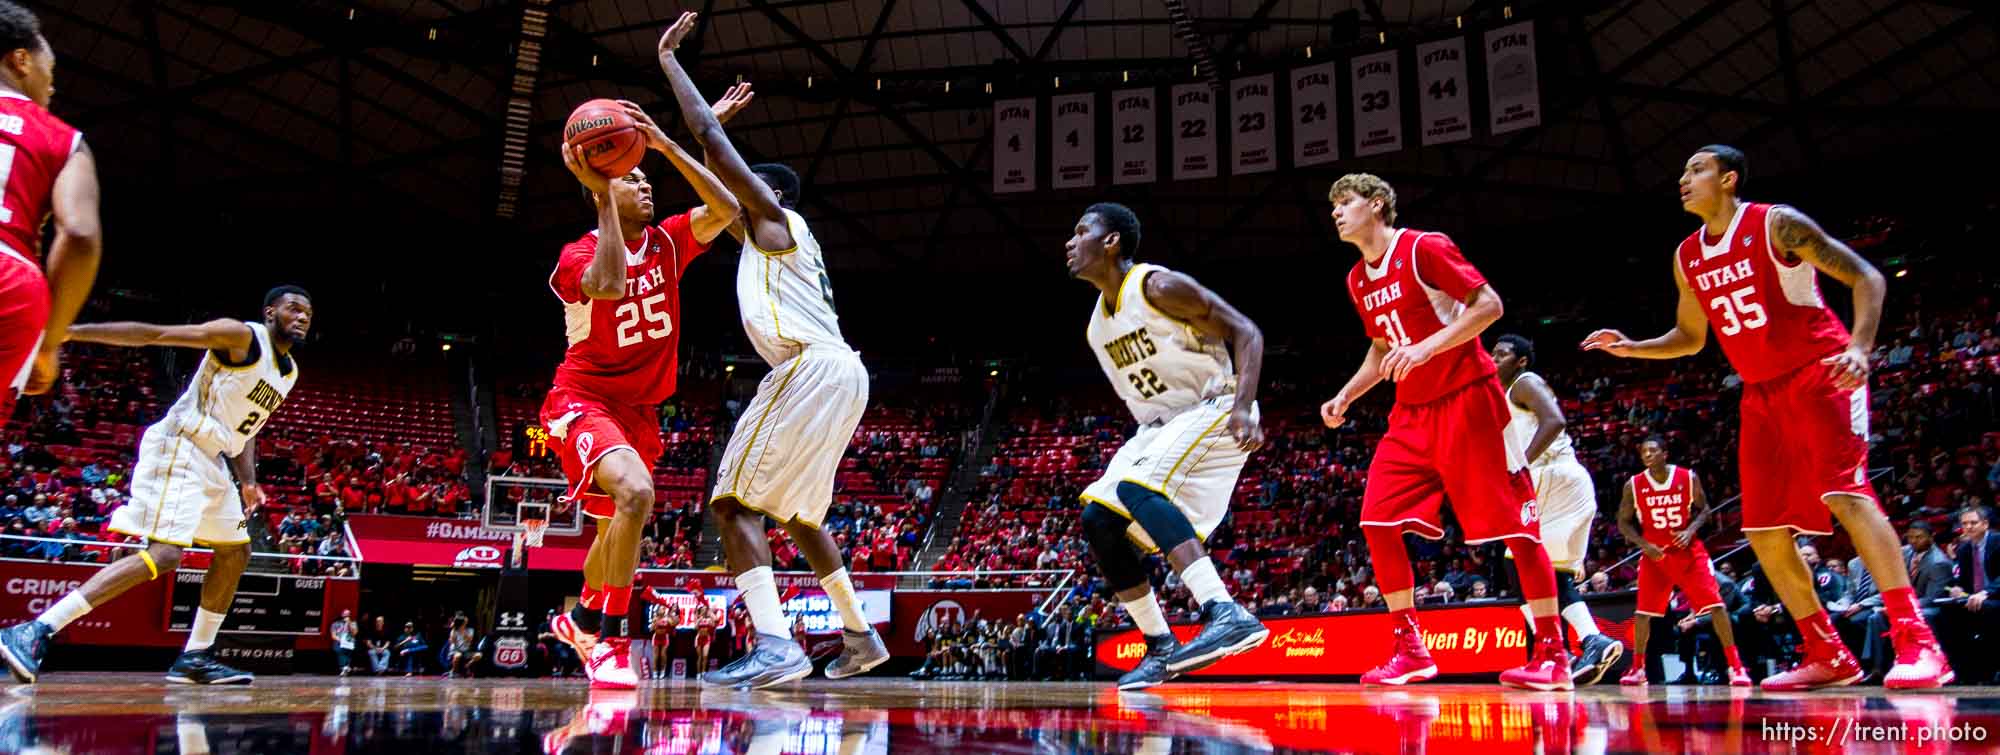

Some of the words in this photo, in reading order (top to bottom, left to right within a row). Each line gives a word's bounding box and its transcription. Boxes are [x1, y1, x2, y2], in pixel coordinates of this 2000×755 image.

[1492, 33, 1527, 52] UTAH
[1424, 49, 1458, 66] UTAH
[1358, 62, 1391, 78] UTAH
[1297, 73, 1329, 90] UTAH
[1429, 78, 1457, 99] 44
[1178, 91, 1209, 106] UTAH
[1237, 83, 1269, 100] UTAH
[1058, 101, 1088, 116] UTAH
[1118, 96, 1149, 111] UTAH
[1361, 90, 1389, 112] 33
[1000, 107, 1030, 121] UTAH
[1301, 102, 1327, 123] 24
[566, 114, 615, 140] Wilson
[1181, 119, 1206, 138] 22
[1239, 112, 1265, 133] 23
[1008, 134, 1020, 152] 4
[1066, 130, 1078, 148] 4
[1123, 125, 1145, 143] 12
[586, 138, 616, 158] CAA
[626, 264, 666, 298] TAH
[1695, 258, 1755, 292] UTAH
[1363, 281, 1403, 311] UTAH
[615, 292, 673, 348] 25
[1710, 285, 1768, 337] 35
[1375, 308, 1412, 350] 31
[1128, 367, 1169, 400] 22
[529, 440, 546, 458] 17
[1646, 493, 1683, 507] UTAH
[1650, 506, 1684, 529] 55
[295, 578, 324, 590] GUEST
[1463, 627, 1488, 654] By
[215, 648, 294, 659] ETWORKS
[500, 650, 521, 662] 66
[1116, 642, 1148, 659] LARR
